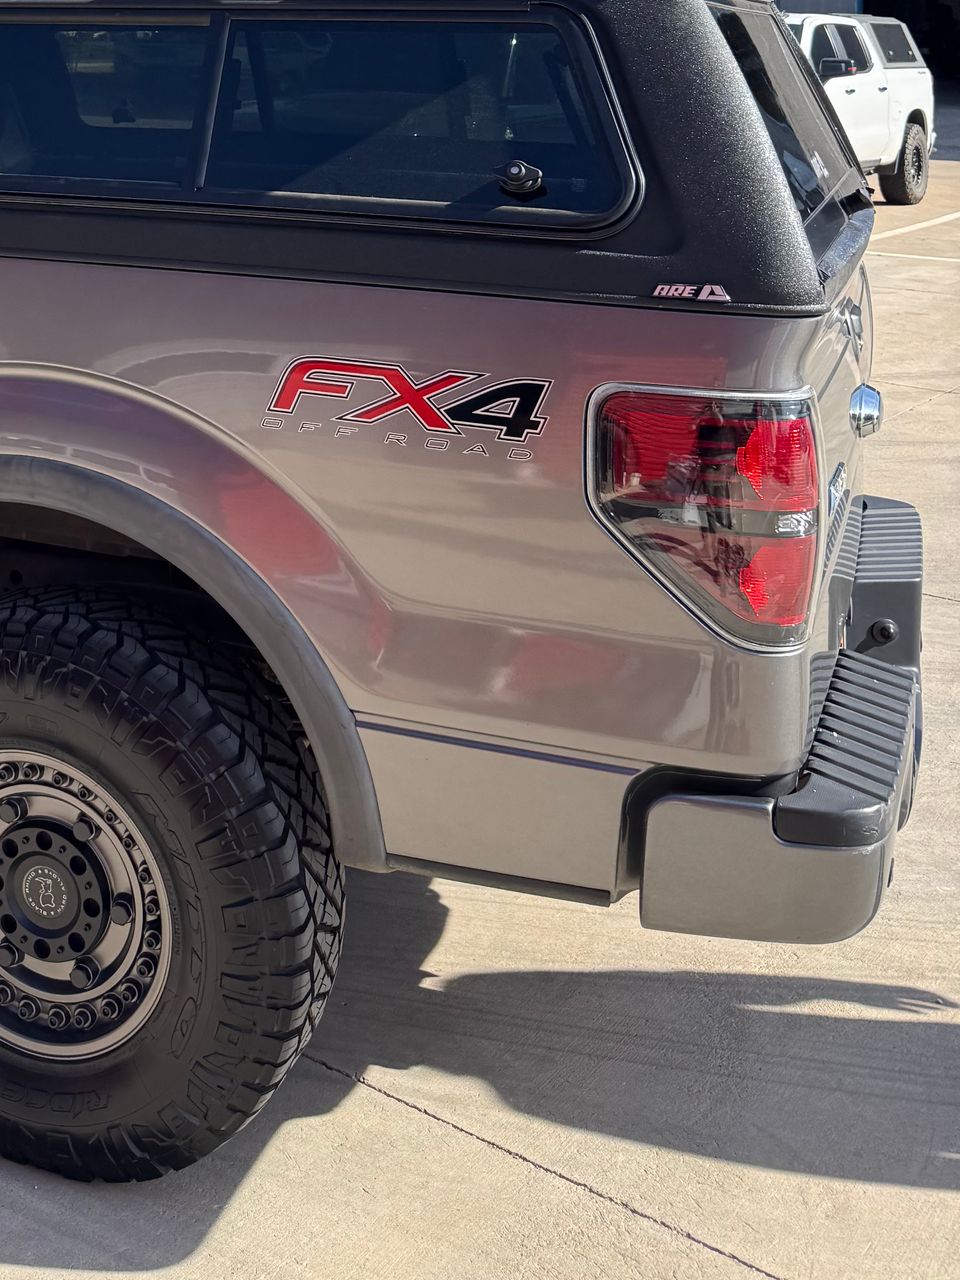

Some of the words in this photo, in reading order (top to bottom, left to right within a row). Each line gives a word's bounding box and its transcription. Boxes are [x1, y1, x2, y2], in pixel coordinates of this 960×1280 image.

[652, 284, 697, 297] ARE
[266, 354, 554, 444] FX4
[261, 416, 359, 438] OFF
[384, 431, 533, 461] ROAD
